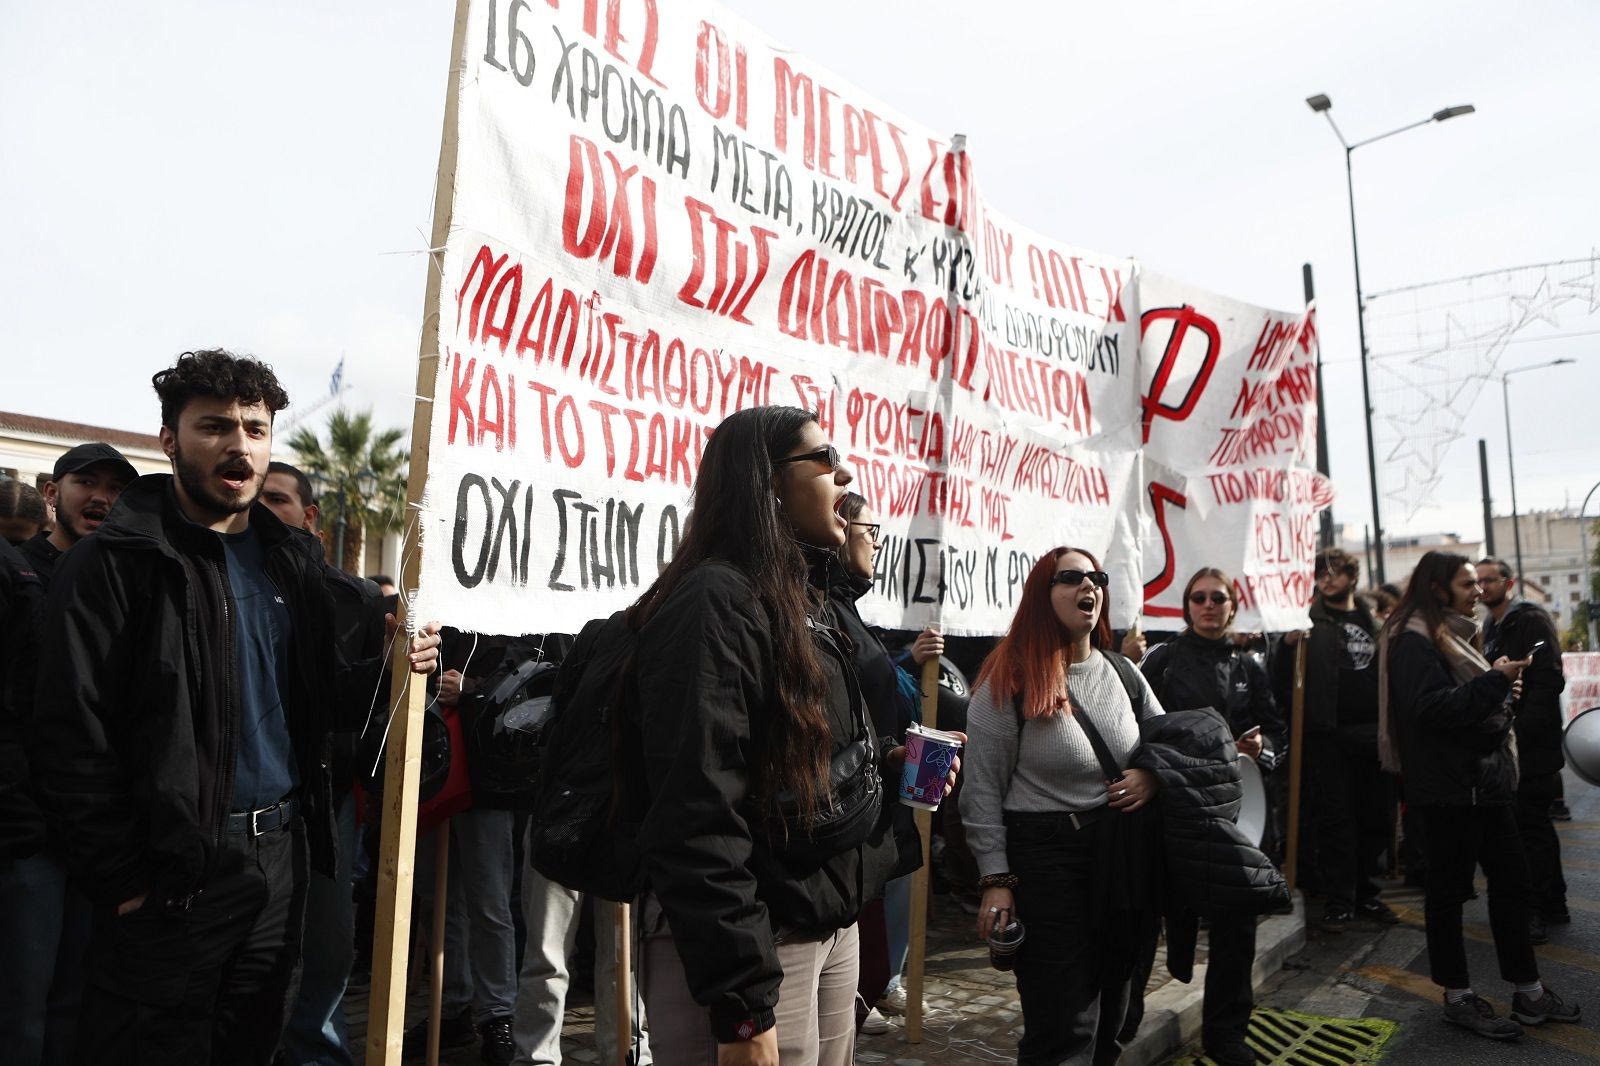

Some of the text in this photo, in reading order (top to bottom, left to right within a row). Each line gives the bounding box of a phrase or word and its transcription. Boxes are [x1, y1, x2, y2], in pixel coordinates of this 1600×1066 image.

[695, 20, 748, 131] ΟΙ
[774, 57, 909, 213] ΜΕΡΕΣ
[561, 134, 658, 285] ΟΧΙ
[677, 195, 780, 327] ΣΤΙΣ
[812, 180, 893, 271] ΚΡΑΤΟΣ
[448, 351, 517, 454] ΚΑΙ
[527, 379, 586, 469] ΤΟ
[980, 486, 1015, 542] ΜΑΣ
[451, 472, 534, 589] ΟΧΙ
[547, 488, 645, 592] ΣΤΗΝ
